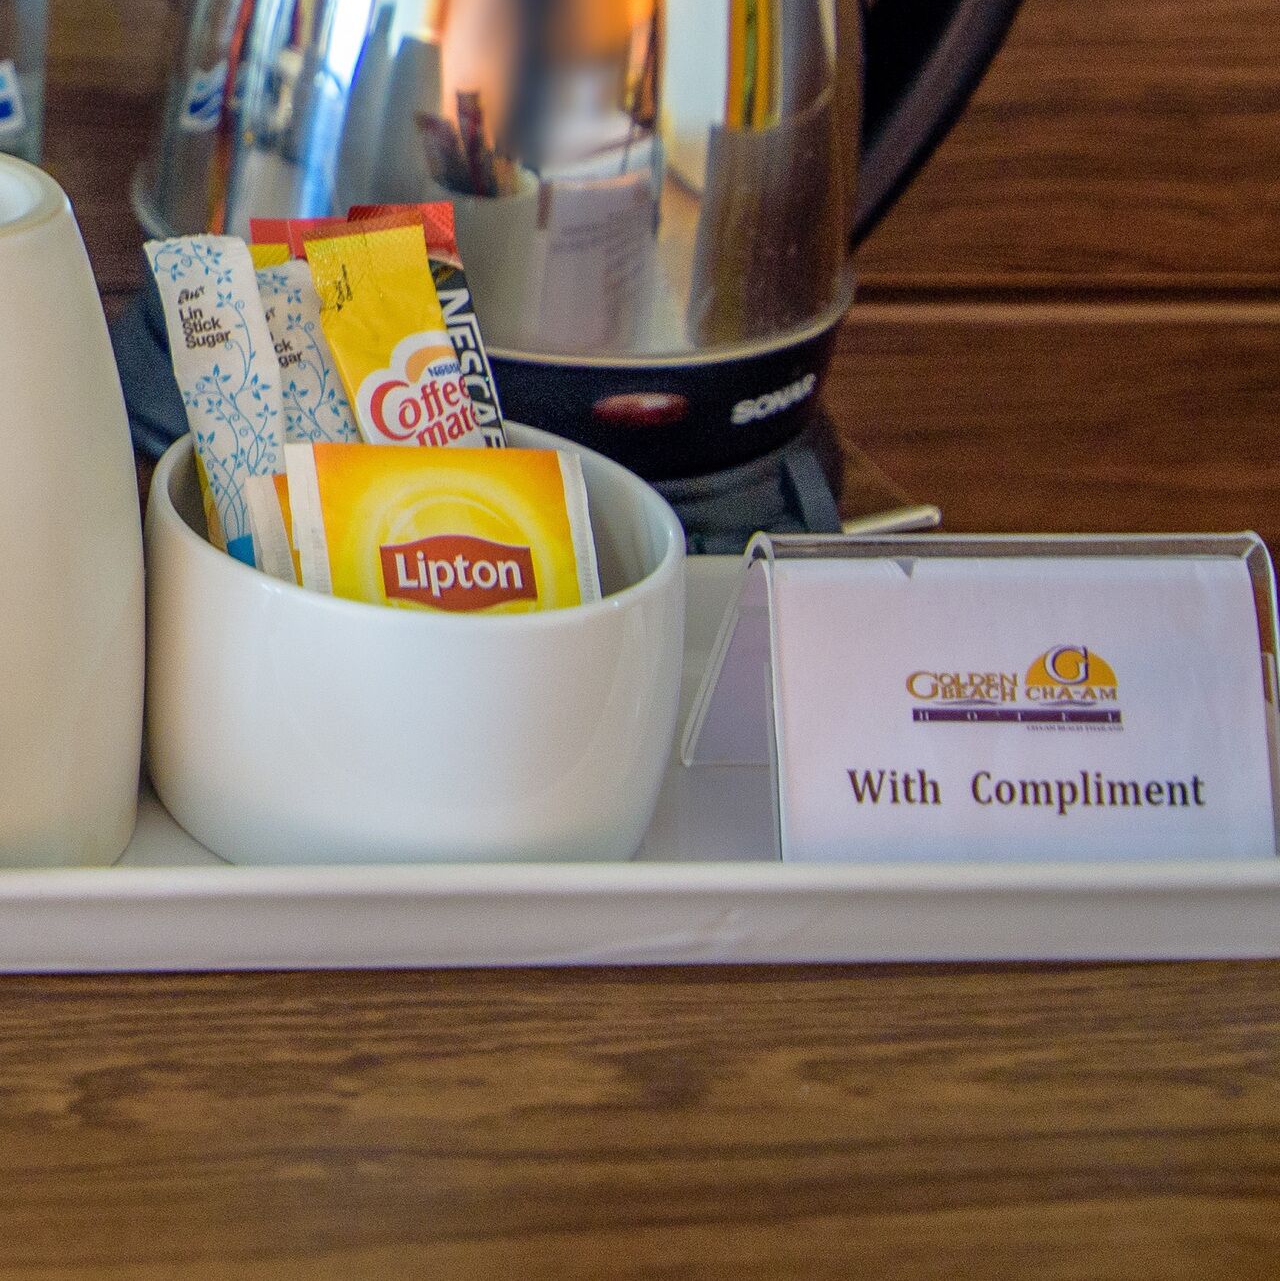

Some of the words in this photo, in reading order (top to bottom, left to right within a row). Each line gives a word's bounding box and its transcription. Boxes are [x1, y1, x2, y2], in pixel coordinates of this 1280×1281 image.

[178, 306, 203, 322] Lin
[182, 318, 222, 336] Stick
[185, 330, 231, 350] Sugar
[278, 350, 303, 368] gar
[370, 375, 471, 441] Coffee
[394, 550, 524, 598] Lipton
[906, 670, 1019, 700] GOLDEN
[941, 685, 1017, 702] BEACH
[1025, 685, 1118, 701] CHA-AM
[848, 768, 942, 805] With
[970, 770, 1206, 816] Compliment
